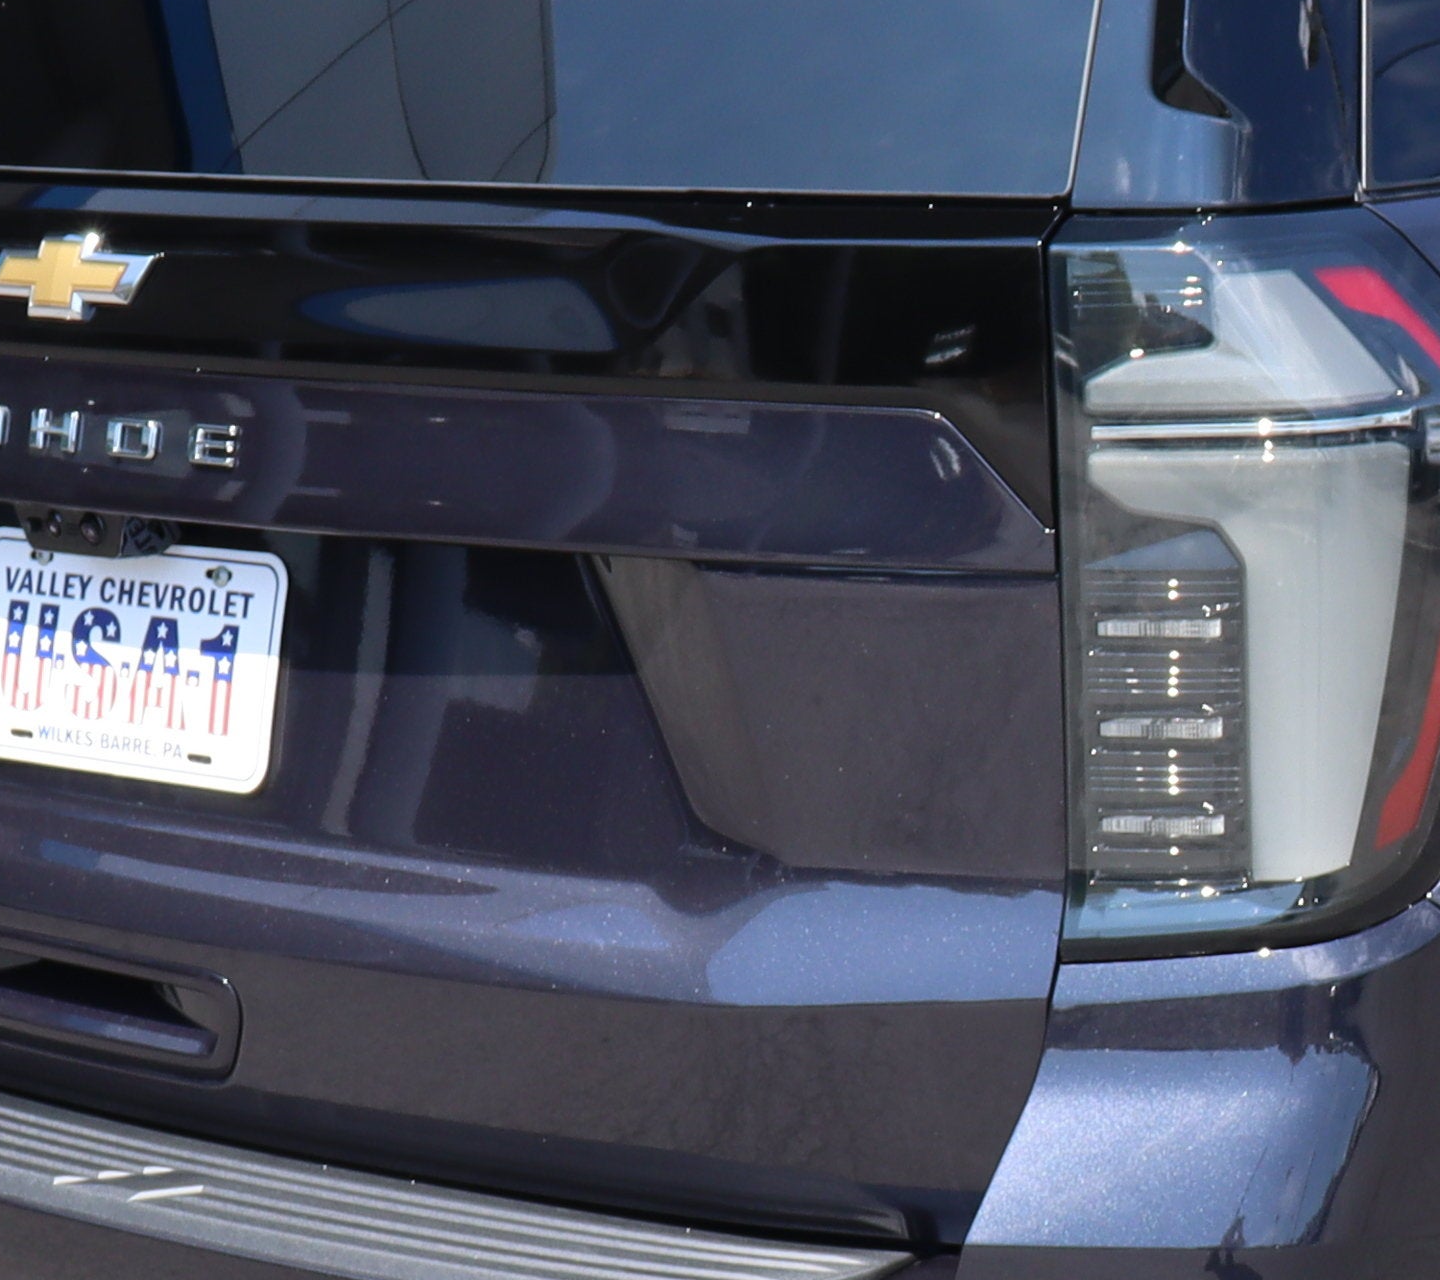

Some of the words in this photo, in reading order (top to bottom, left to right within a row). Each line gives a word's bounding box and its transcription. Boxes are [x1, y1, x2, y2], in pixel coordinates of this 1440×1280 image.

[5, 566, 93, 601] VALLEY
[100, 577, 255, 619] CHEVROLET
[37, 724, 94, 747] WILKES
[163, 740, 183, 760] PA
